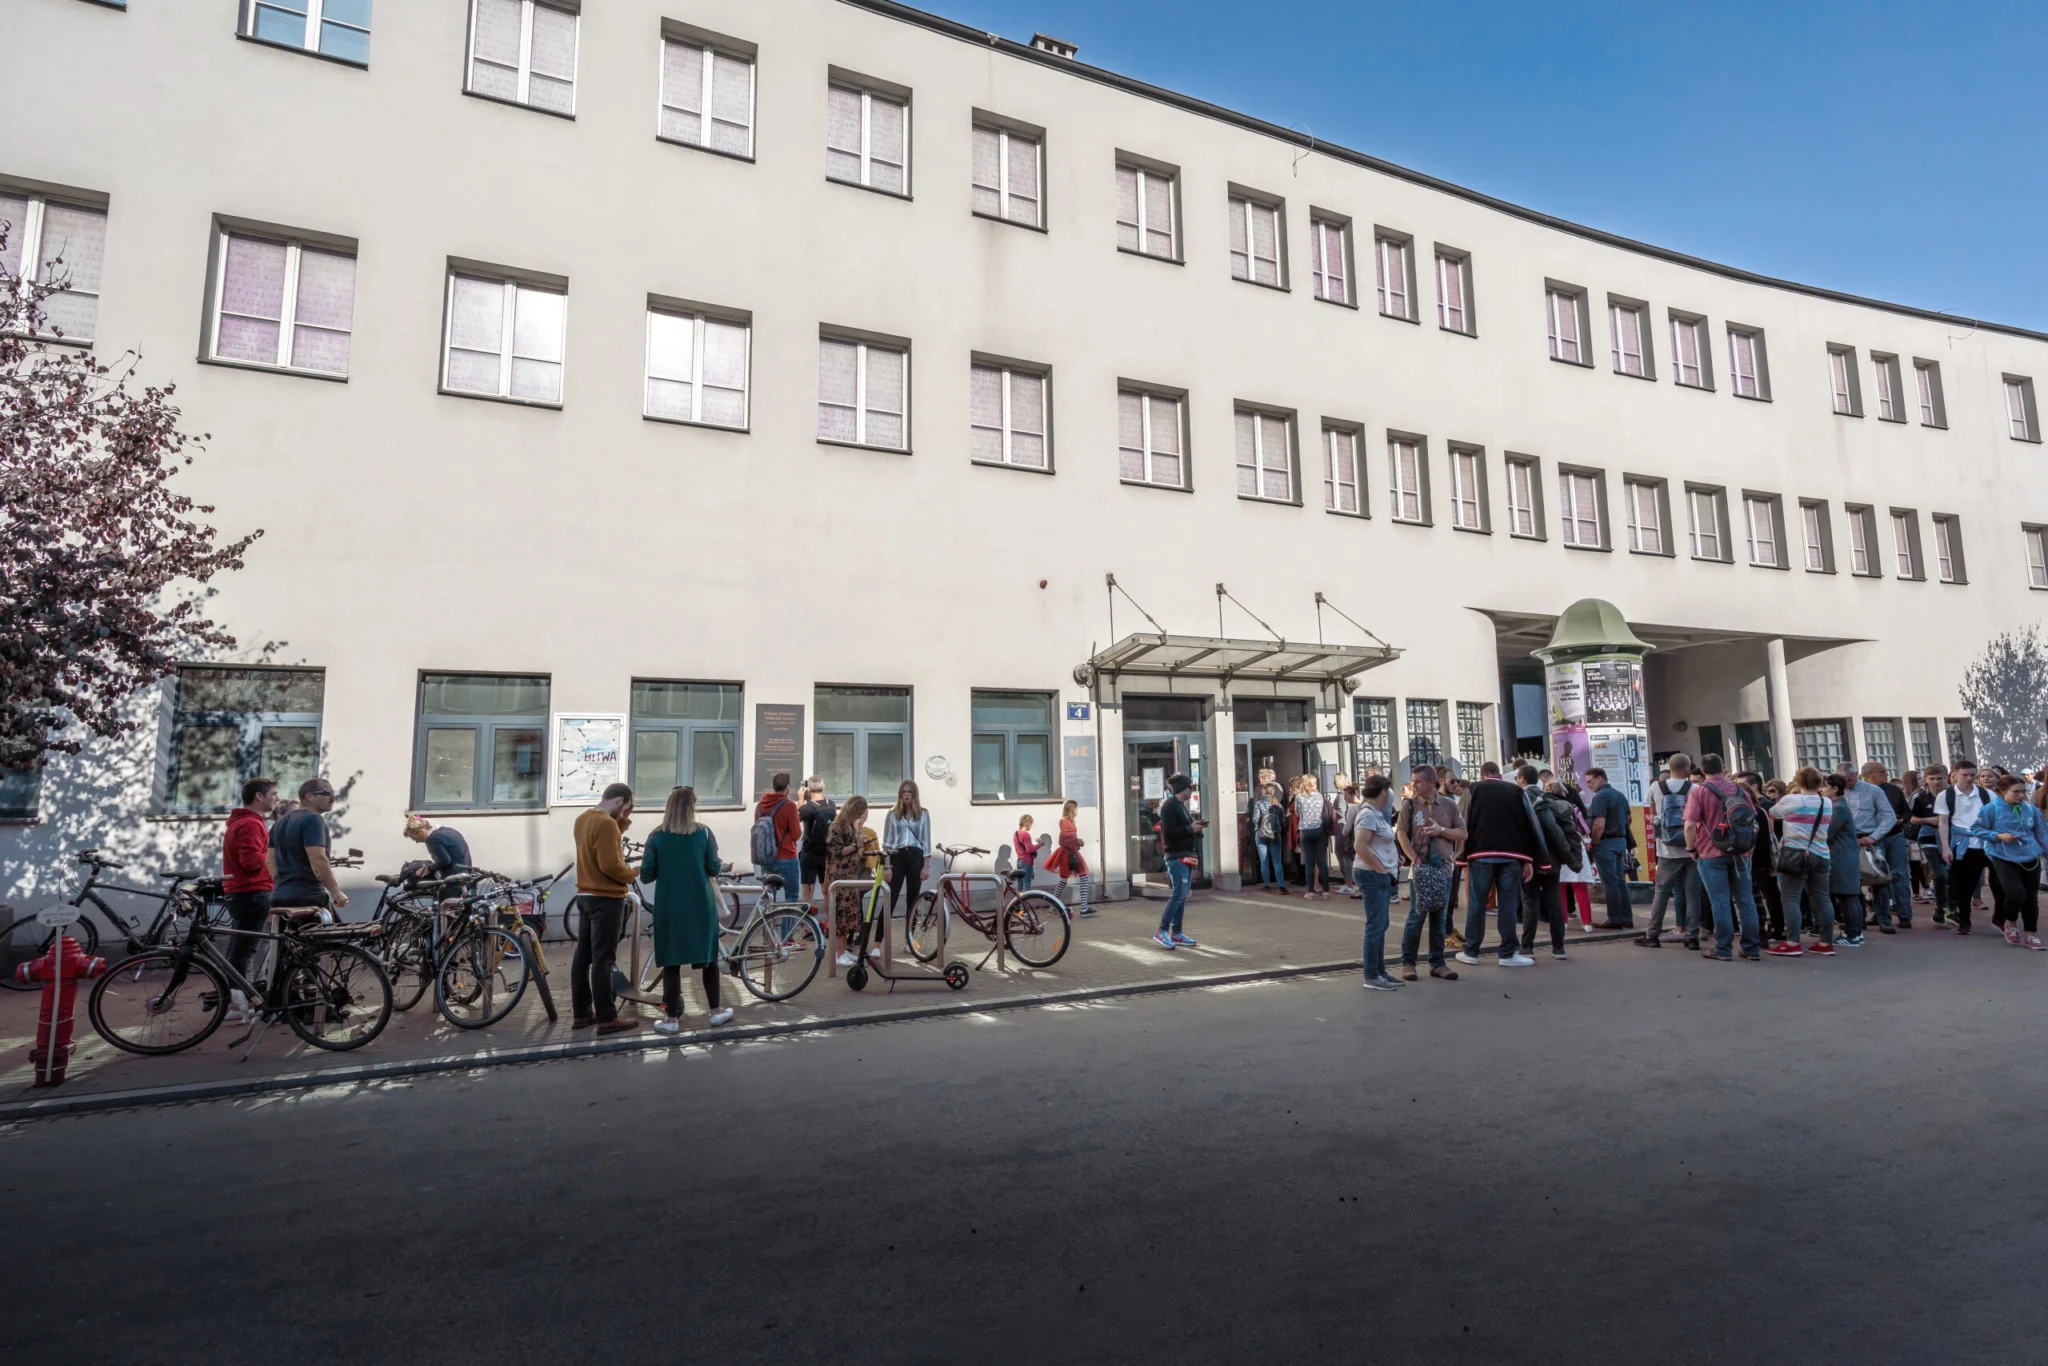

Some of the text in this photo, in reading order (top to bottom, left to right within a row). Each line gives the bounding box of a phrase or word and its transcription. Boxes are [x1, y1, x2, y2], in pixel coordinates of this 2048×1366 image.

[1075, 708, 1082, 718] 4
[1069, 745, 1090, 757] MK
[1620, 735, 1636, 759] de
[584, 751, 617, 762] BITWA
[1626, 780, 1640, 803] ta
[1412, 810, 1426, 826] 4
